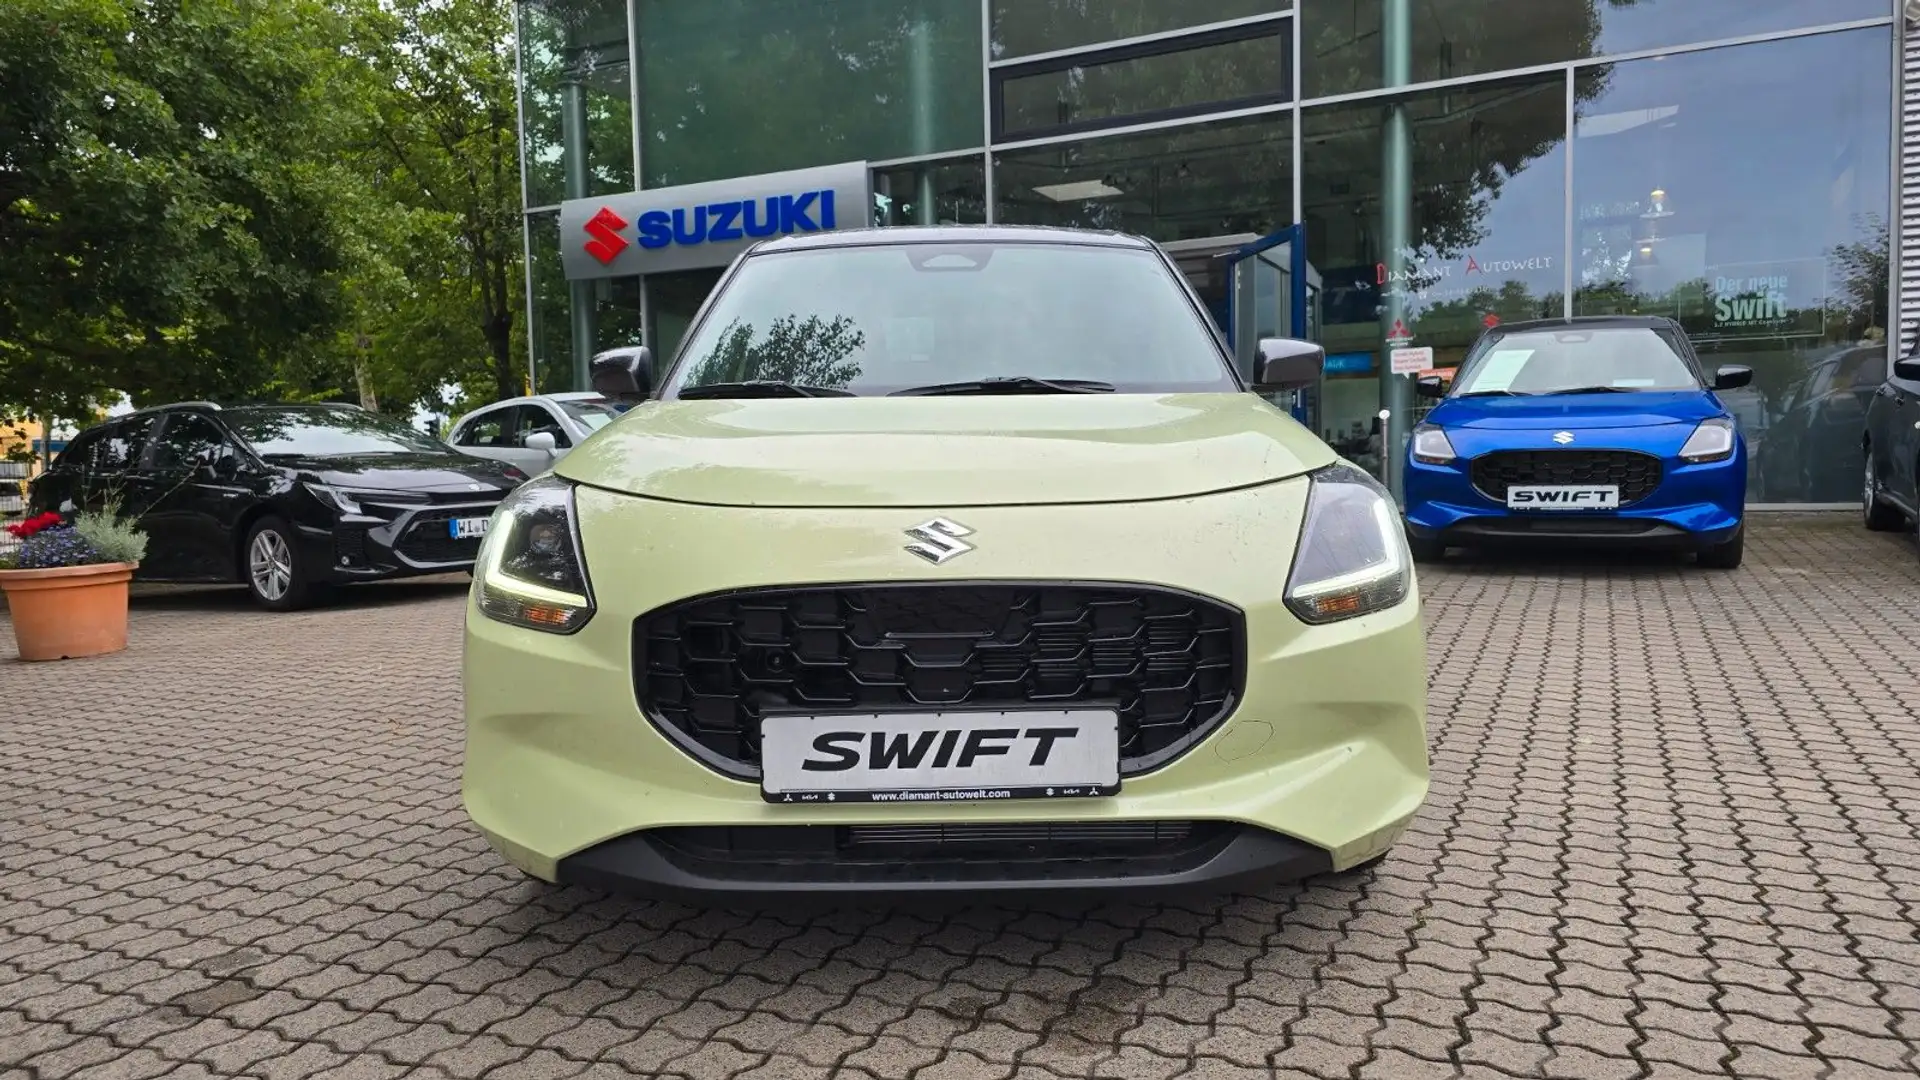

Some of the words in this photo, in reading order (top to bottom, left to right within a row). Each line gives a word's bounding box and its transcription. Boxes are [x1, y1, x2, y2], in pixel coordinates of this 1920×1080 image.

[637, 190, 836, 250] SUZUKI
[1376, 263, 1451, 285] DIAMANT
[1466, 254, 1552, 277] AUTOWELT
[1715, 276, 1744, 292] Der
[1748, 275, 1788, 290] neue
[1714, 290, 1788, 322] Swift
[1513, 491, 1614, 503] SWIFT
[801, 727, 1079, 772] SWIFT
[872, 789, 1011, 802] www.diamant-autowelt.com
